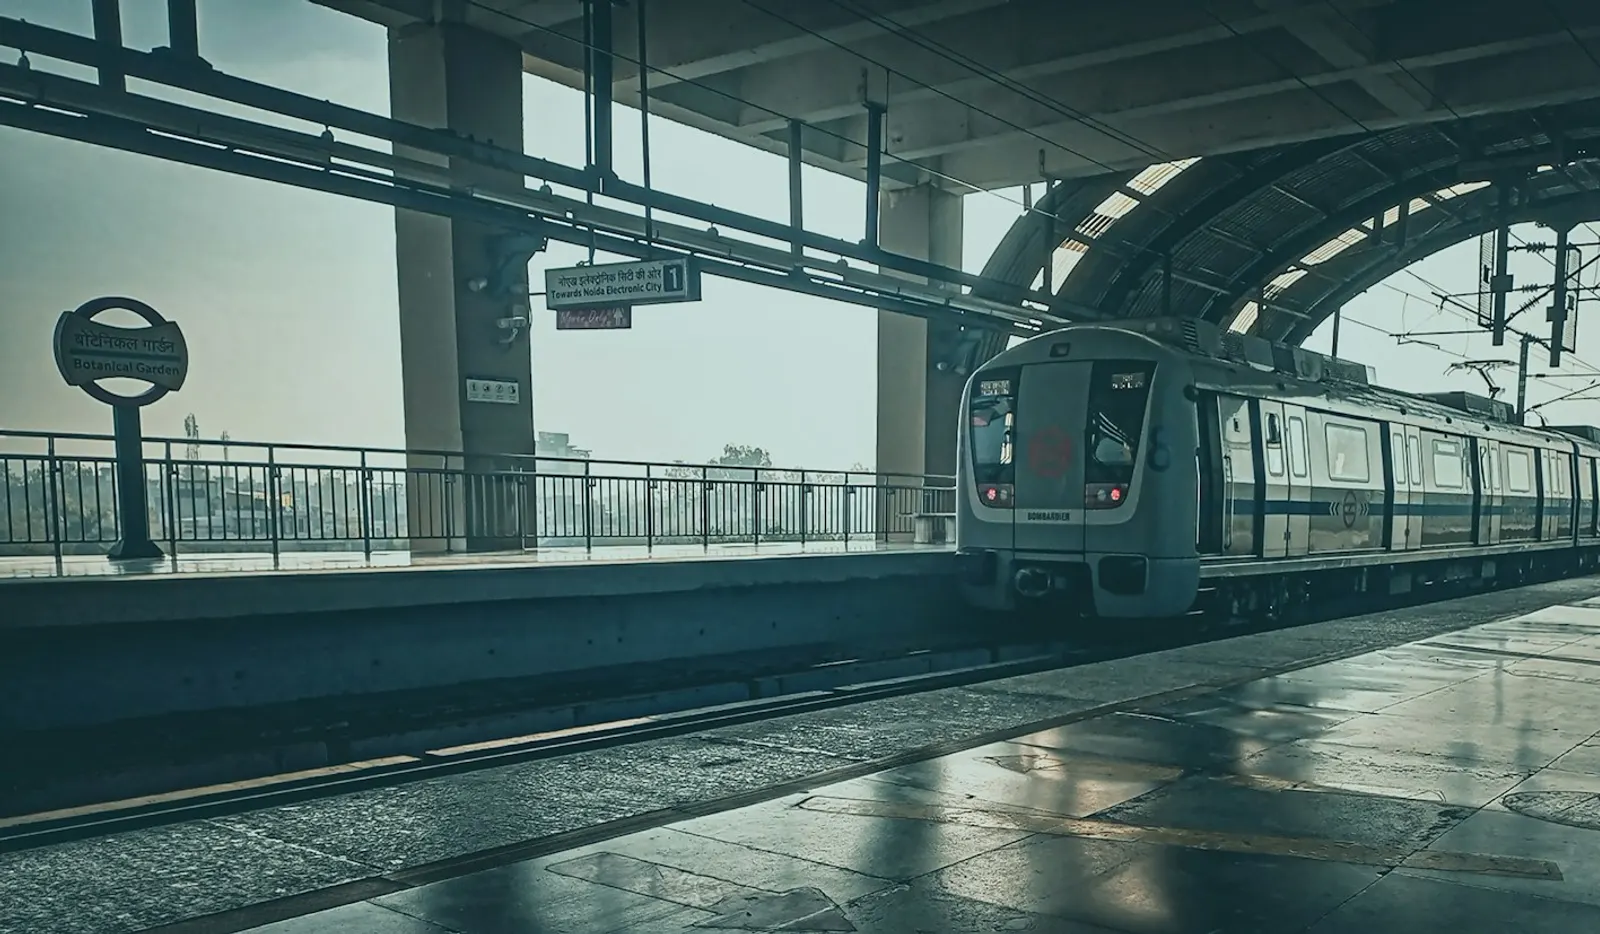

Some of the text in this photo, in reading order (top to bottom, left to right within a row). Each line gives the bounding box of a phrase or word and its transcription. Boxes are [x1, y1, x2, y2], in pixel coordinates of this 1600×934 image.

[669, 267, 678, 289] 1
[551, 282, 662, 299] Towards Noida Electronic City
[142, 336, 175, 353] गार्डन
[74, 359, 180, 376] Botanical Garden
